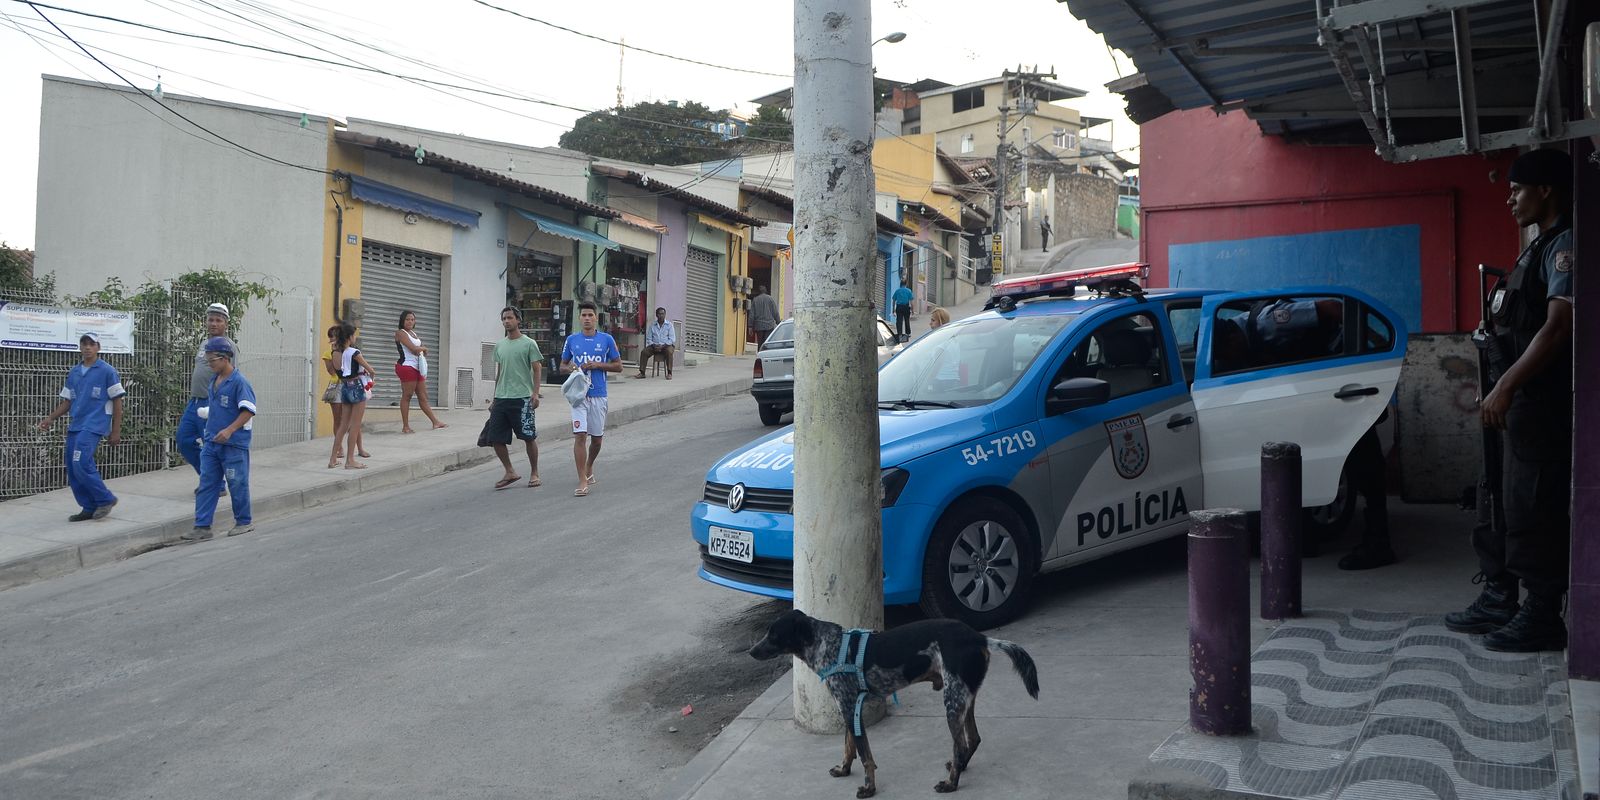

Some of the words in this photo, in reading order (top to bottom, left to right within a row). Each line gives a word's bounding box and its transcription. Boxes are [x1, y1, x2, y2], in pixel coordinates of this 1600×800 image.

[6, 305, 43, 313] SUPLETIVO
[576, 351, 602, 363] vivo
[961, 430, 1036, 466] 54-7219
[1077, 486, 1188, 547] POLÍCIA
